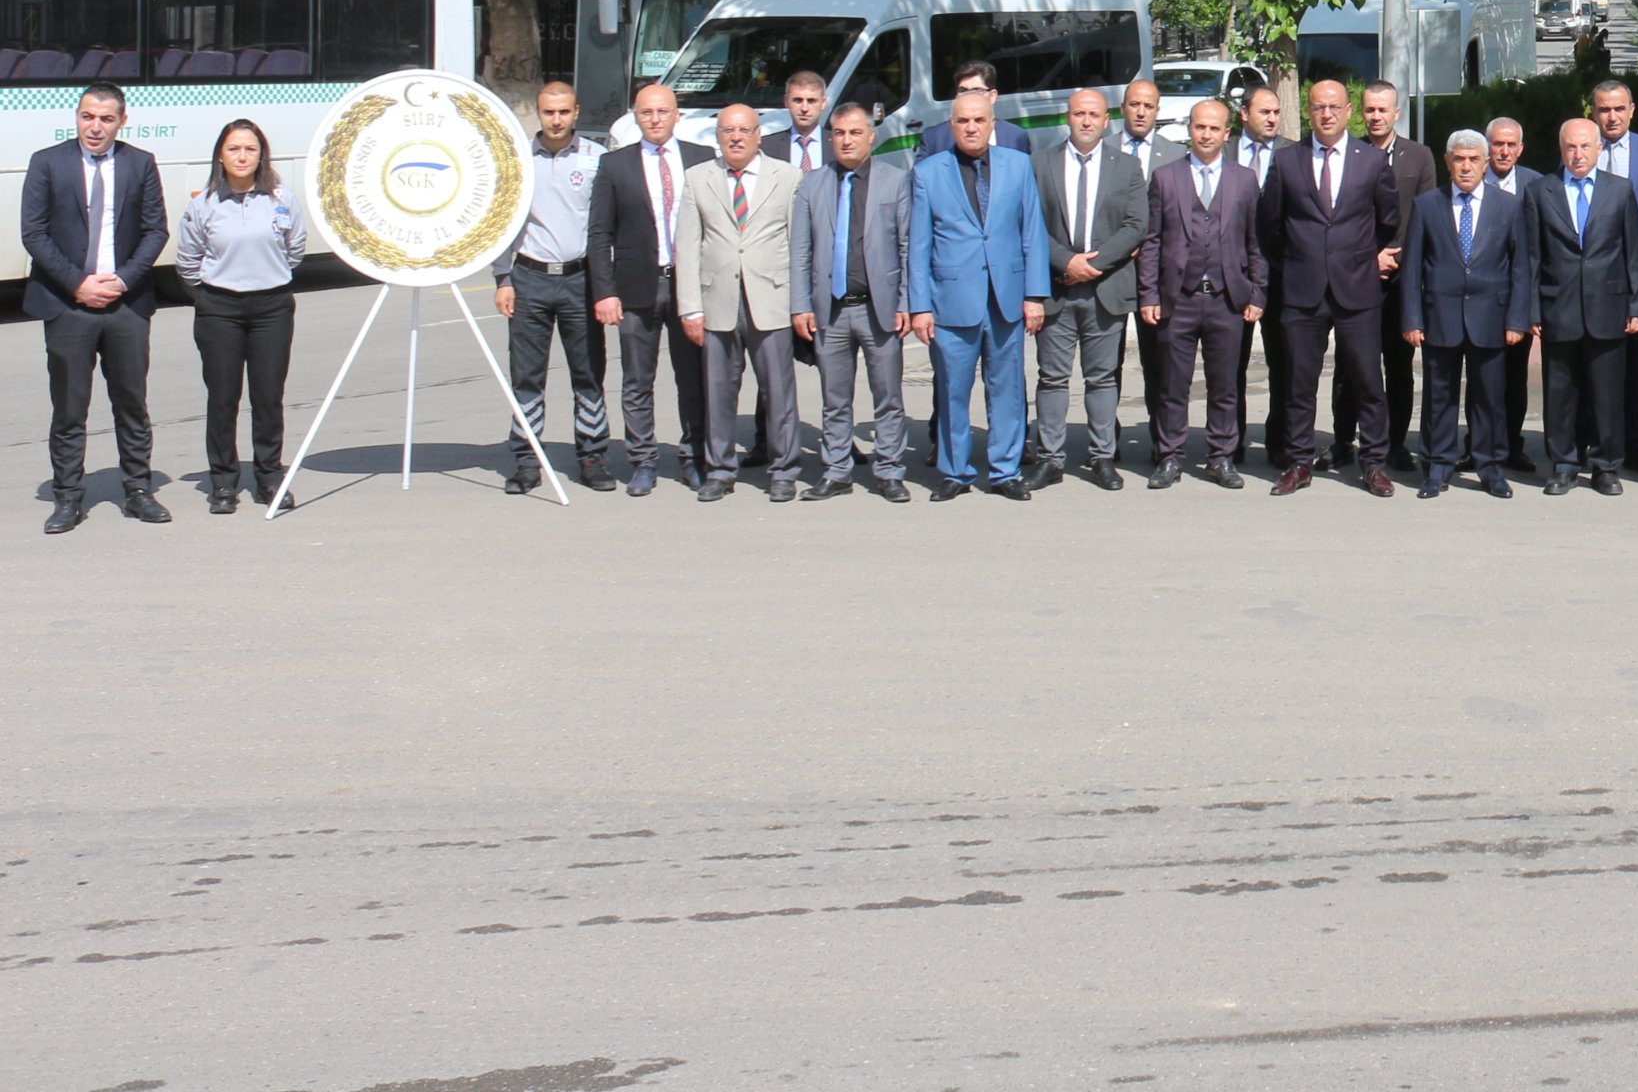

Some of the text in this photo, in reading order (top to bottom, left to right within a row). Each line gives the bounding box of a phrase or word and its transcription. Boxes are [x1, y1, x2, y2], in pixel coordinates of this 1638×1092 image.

[402, 111, 446, 128] SİİRT
[352, 136, 378, 189] SOSYAL
[396, 171, 437, 188] SGK
